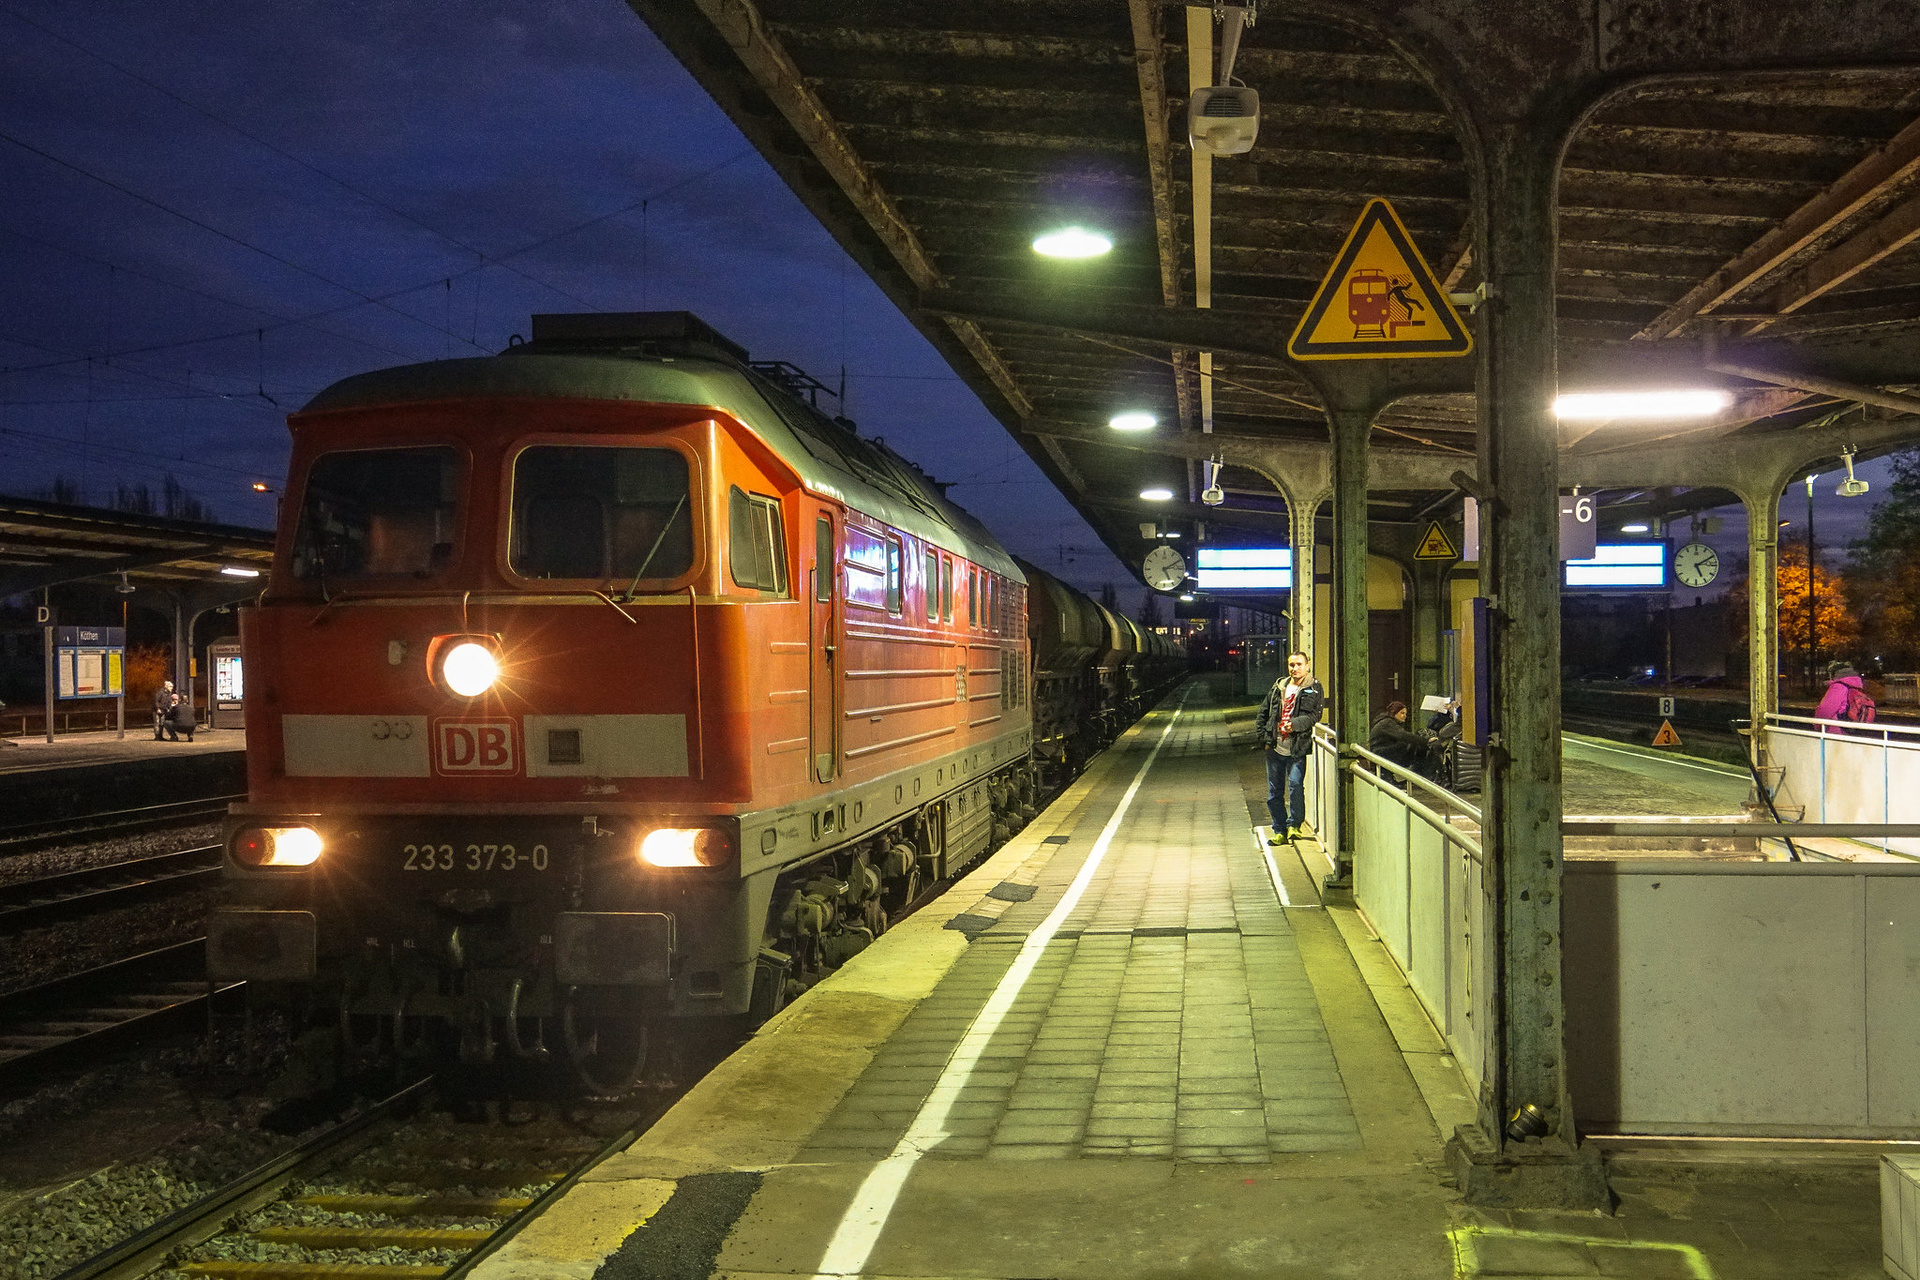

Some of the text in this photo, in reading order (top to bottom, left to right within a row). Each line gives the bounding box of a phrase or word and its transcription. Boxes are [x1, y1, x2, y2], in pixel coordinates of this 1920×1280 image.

[1559, 497, 1593, 523] -6
[37, 606, 50, 622] D
[80, 630, 99, 641] Köthen
[1663, 699, 1670, 714] 8
[1663, 730, 1671, 744] 3
[444, 727, 509, 767] DB
[403, 844, 549, 871] 233 373-0
